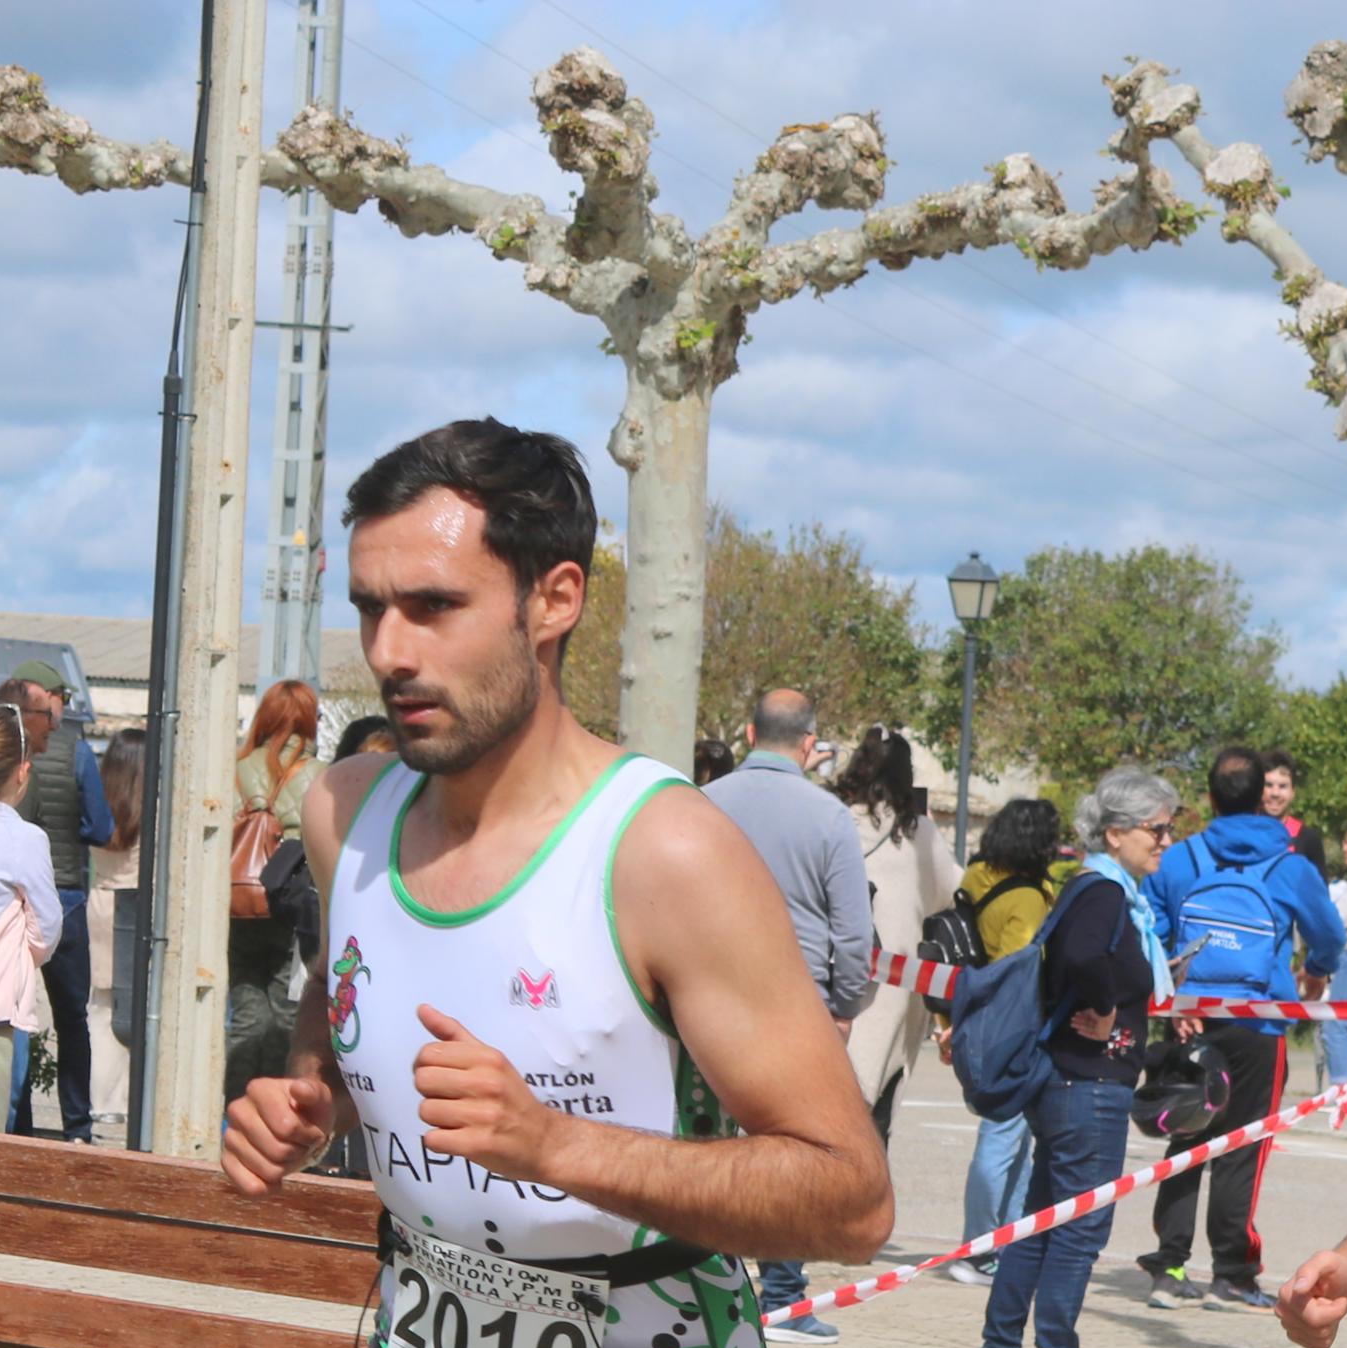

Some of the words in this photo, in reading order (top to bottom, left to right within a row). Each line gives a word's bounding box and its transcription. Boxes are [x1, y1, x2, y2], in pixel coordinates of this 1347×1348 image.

[524, 1072, 595, 1088] ATLÓN
[413, 1233, 549, 1284] FEDERACION
[572, 1280, 602, 1293] DE
[413, 1245, 495, 1284] TRIATLON
[503, 1277, 515, 1288] Y
[416, 1254, 501, 1300] CASTILLA
[512, 1293, 525, 1302] Y
[538, 1297, 582, 1311] LEO
